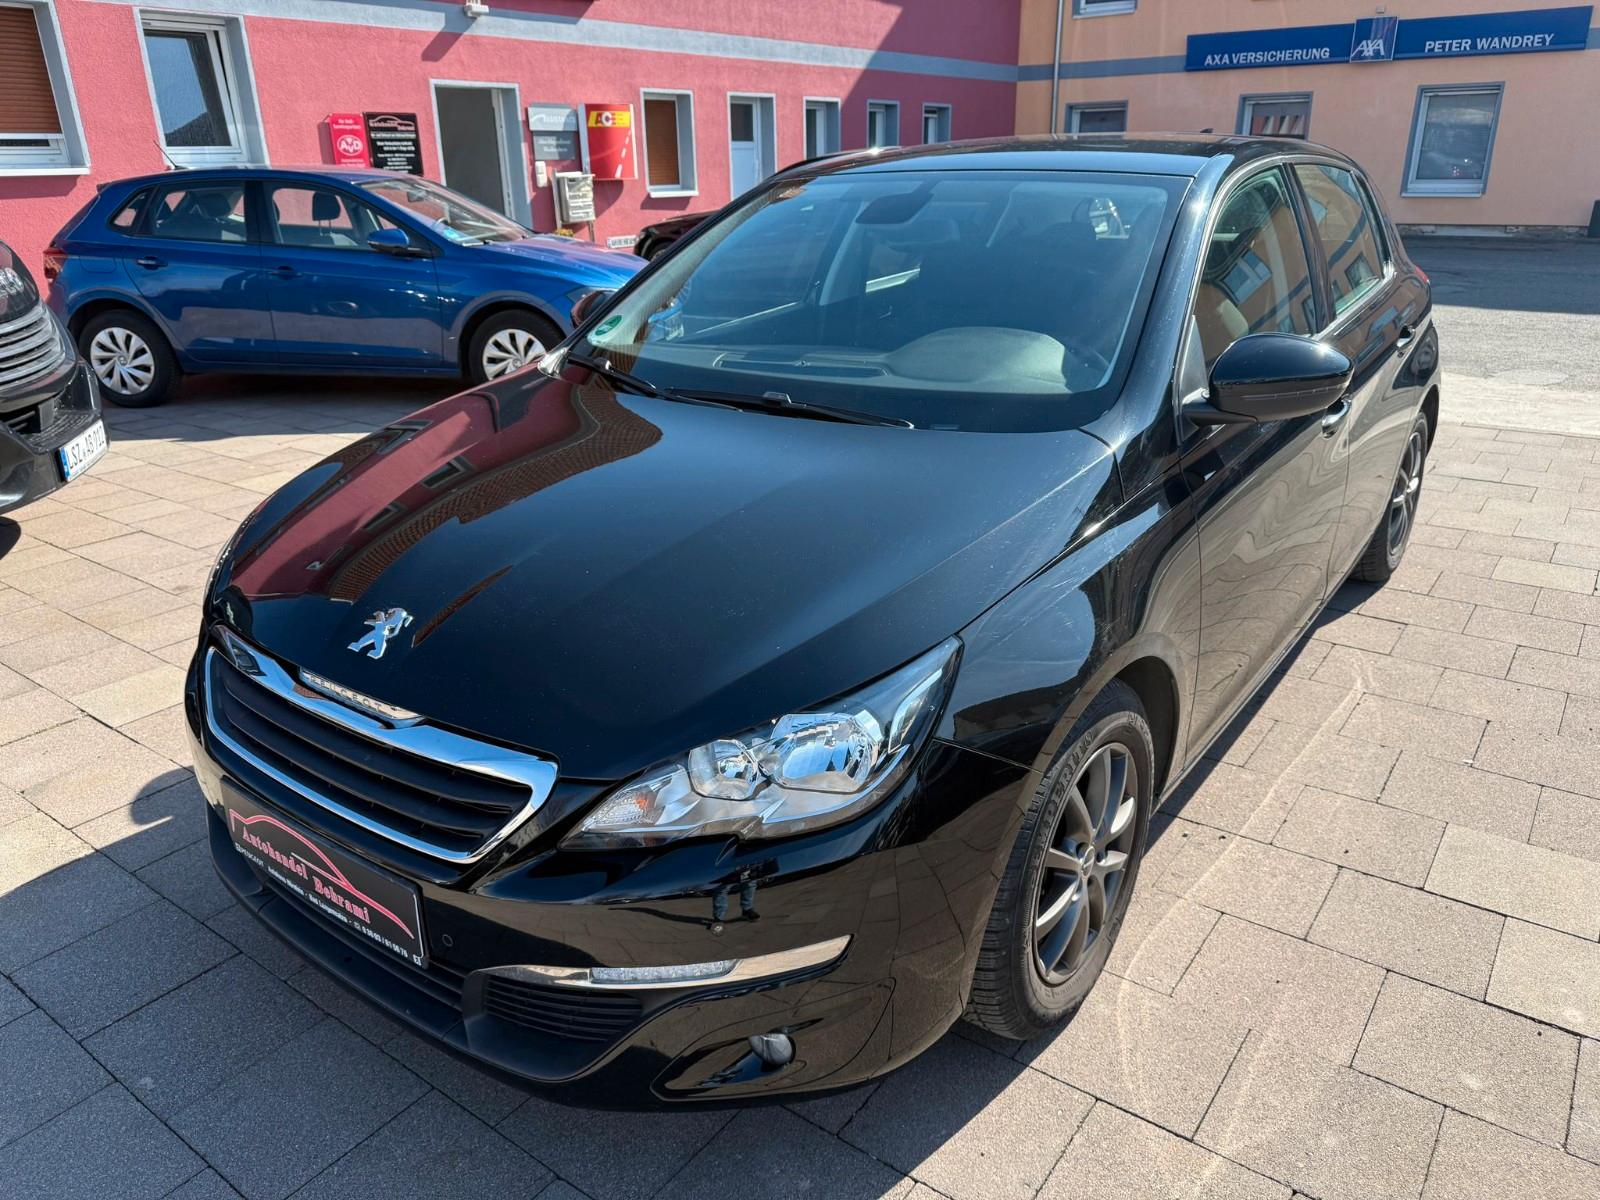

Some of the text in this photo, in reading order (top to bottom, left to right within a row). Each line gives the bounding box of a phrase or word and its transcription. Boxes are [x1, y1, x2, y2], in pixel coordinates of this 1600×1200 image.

[1352, 39, 1385, 57] AXA
[1424, 33, 1554, 53] PETER WANDREY
[1204, 47, 1330, 66] AXA VERSICHERUNG
[310, 675, 382, 712] PEUGEOT
[242, 825, 309, 881] Autohandel
[312, 875, 371, 924] Behrami
